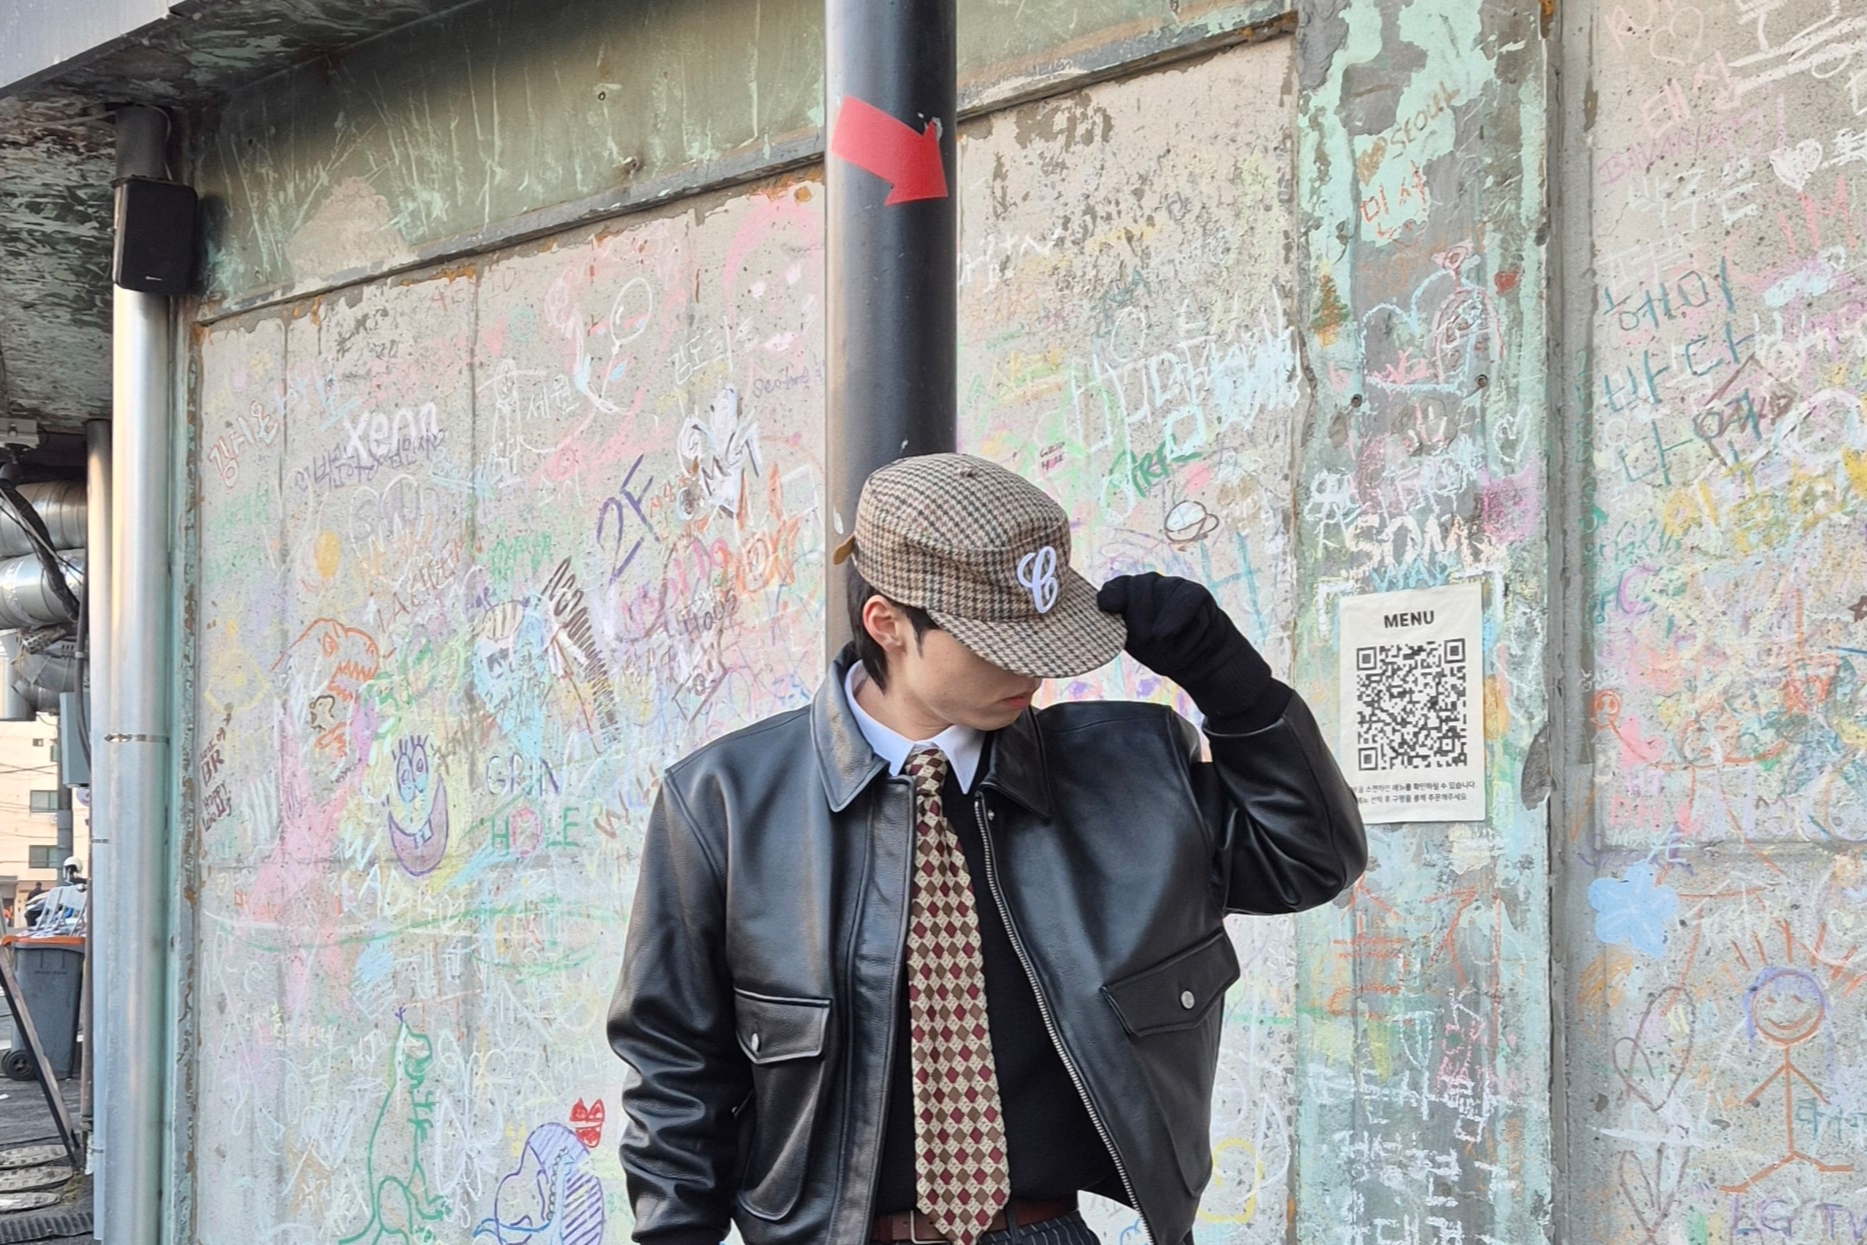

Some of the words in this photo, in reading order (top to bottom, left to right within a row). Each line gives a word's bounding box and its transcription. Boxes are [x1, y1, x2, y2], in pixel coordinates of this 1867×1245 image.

[1390, 81, 1461, 160] SEOUL
[1383, 610, 1435, 629] MENU
[1392, 783, 1412, 792] 메뉴를
[1413, 781, 1439, 791] 확인하실
[1440, 782, 1448, 790] 수
[489, 806, 580, 858] HOLE
